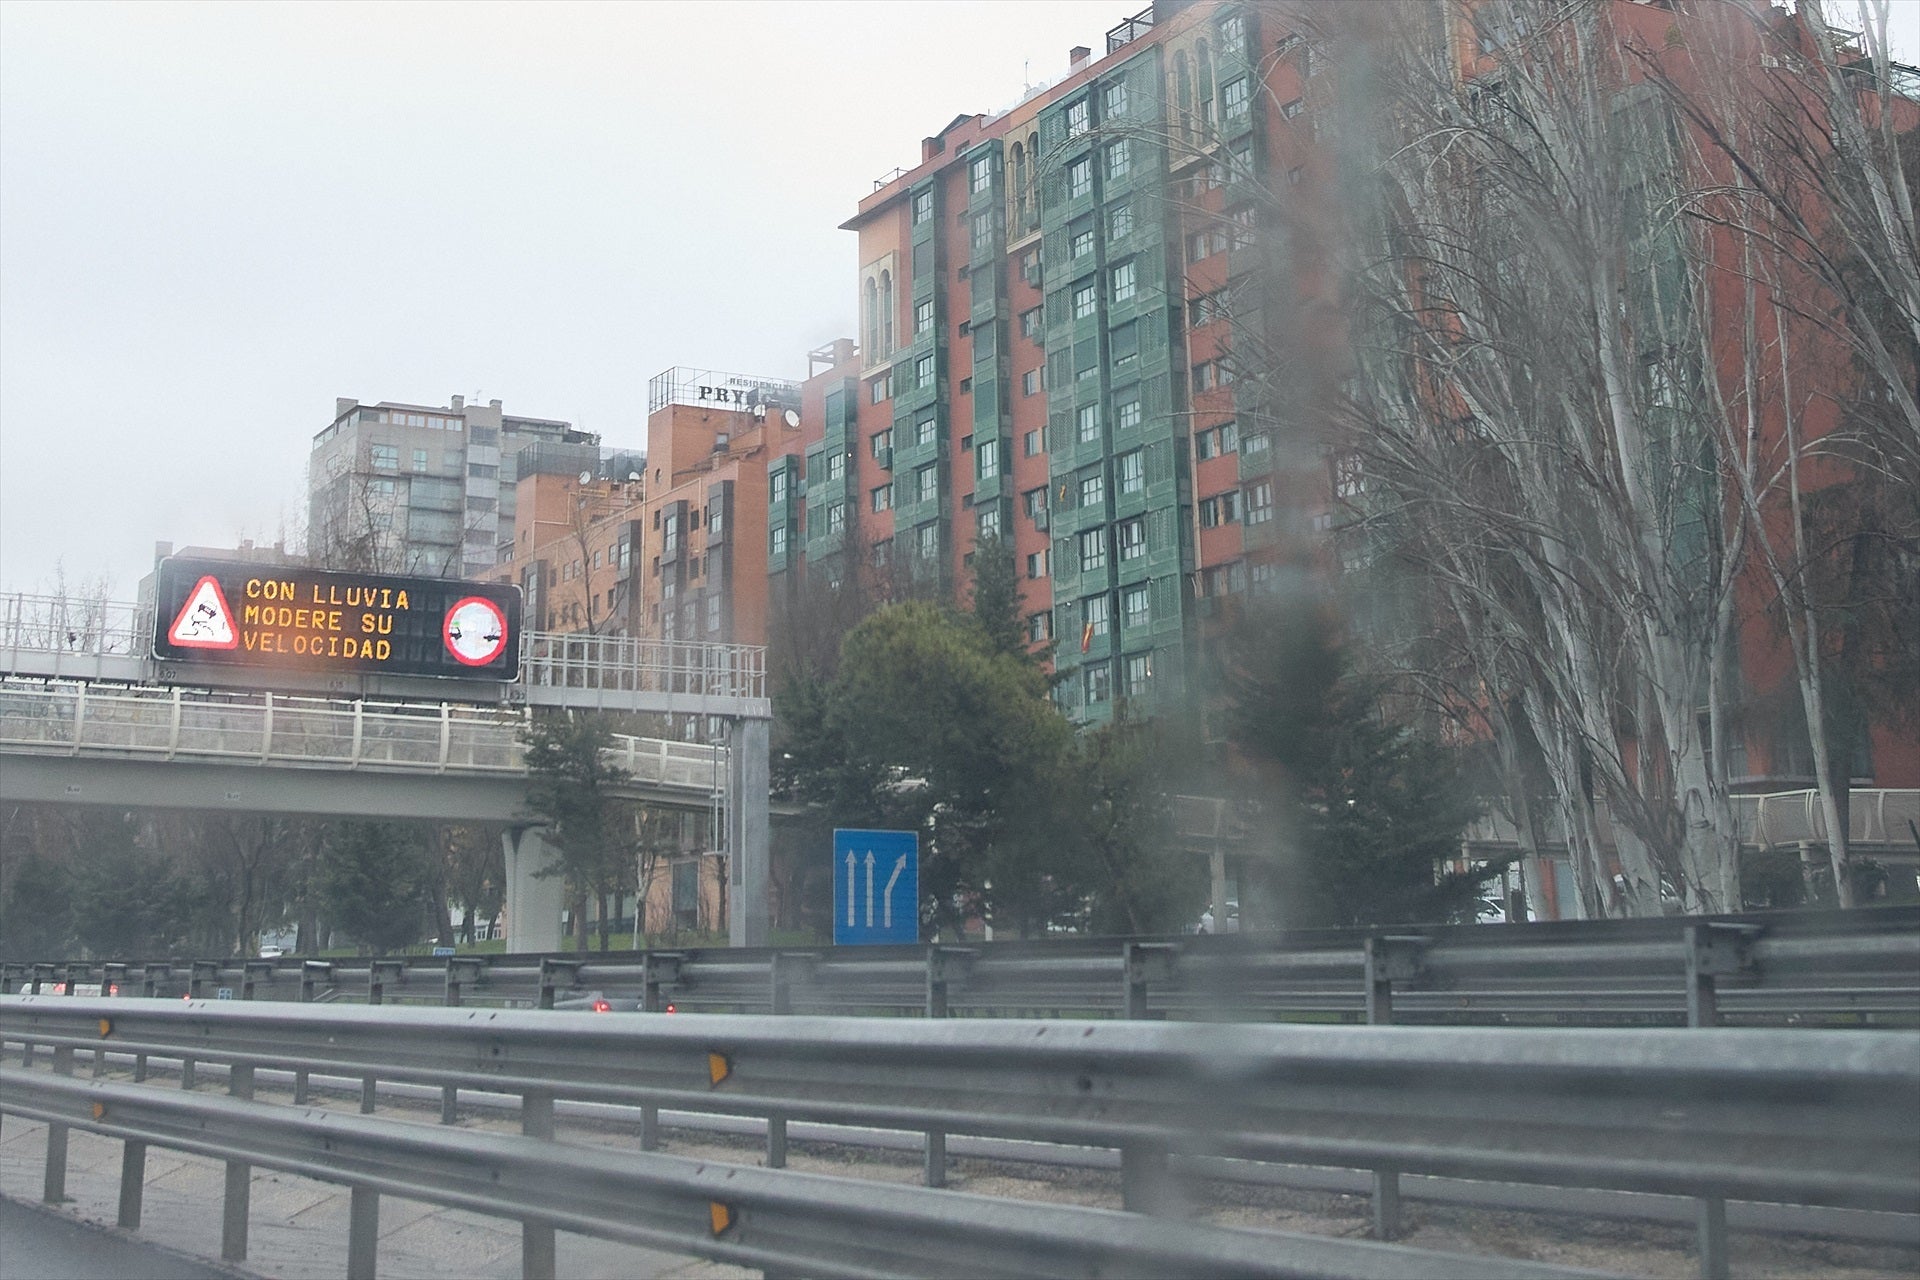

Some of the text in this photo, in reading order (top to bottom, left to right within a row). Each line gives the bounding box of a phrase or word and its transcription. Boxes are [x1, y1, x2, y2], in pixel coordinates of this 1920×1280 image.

[246, 578, 410, 610] CON LLUVIA
[244, 605, 393, 635] MODERE SU
[243, 631, 392, 661] VELOCIDAD
